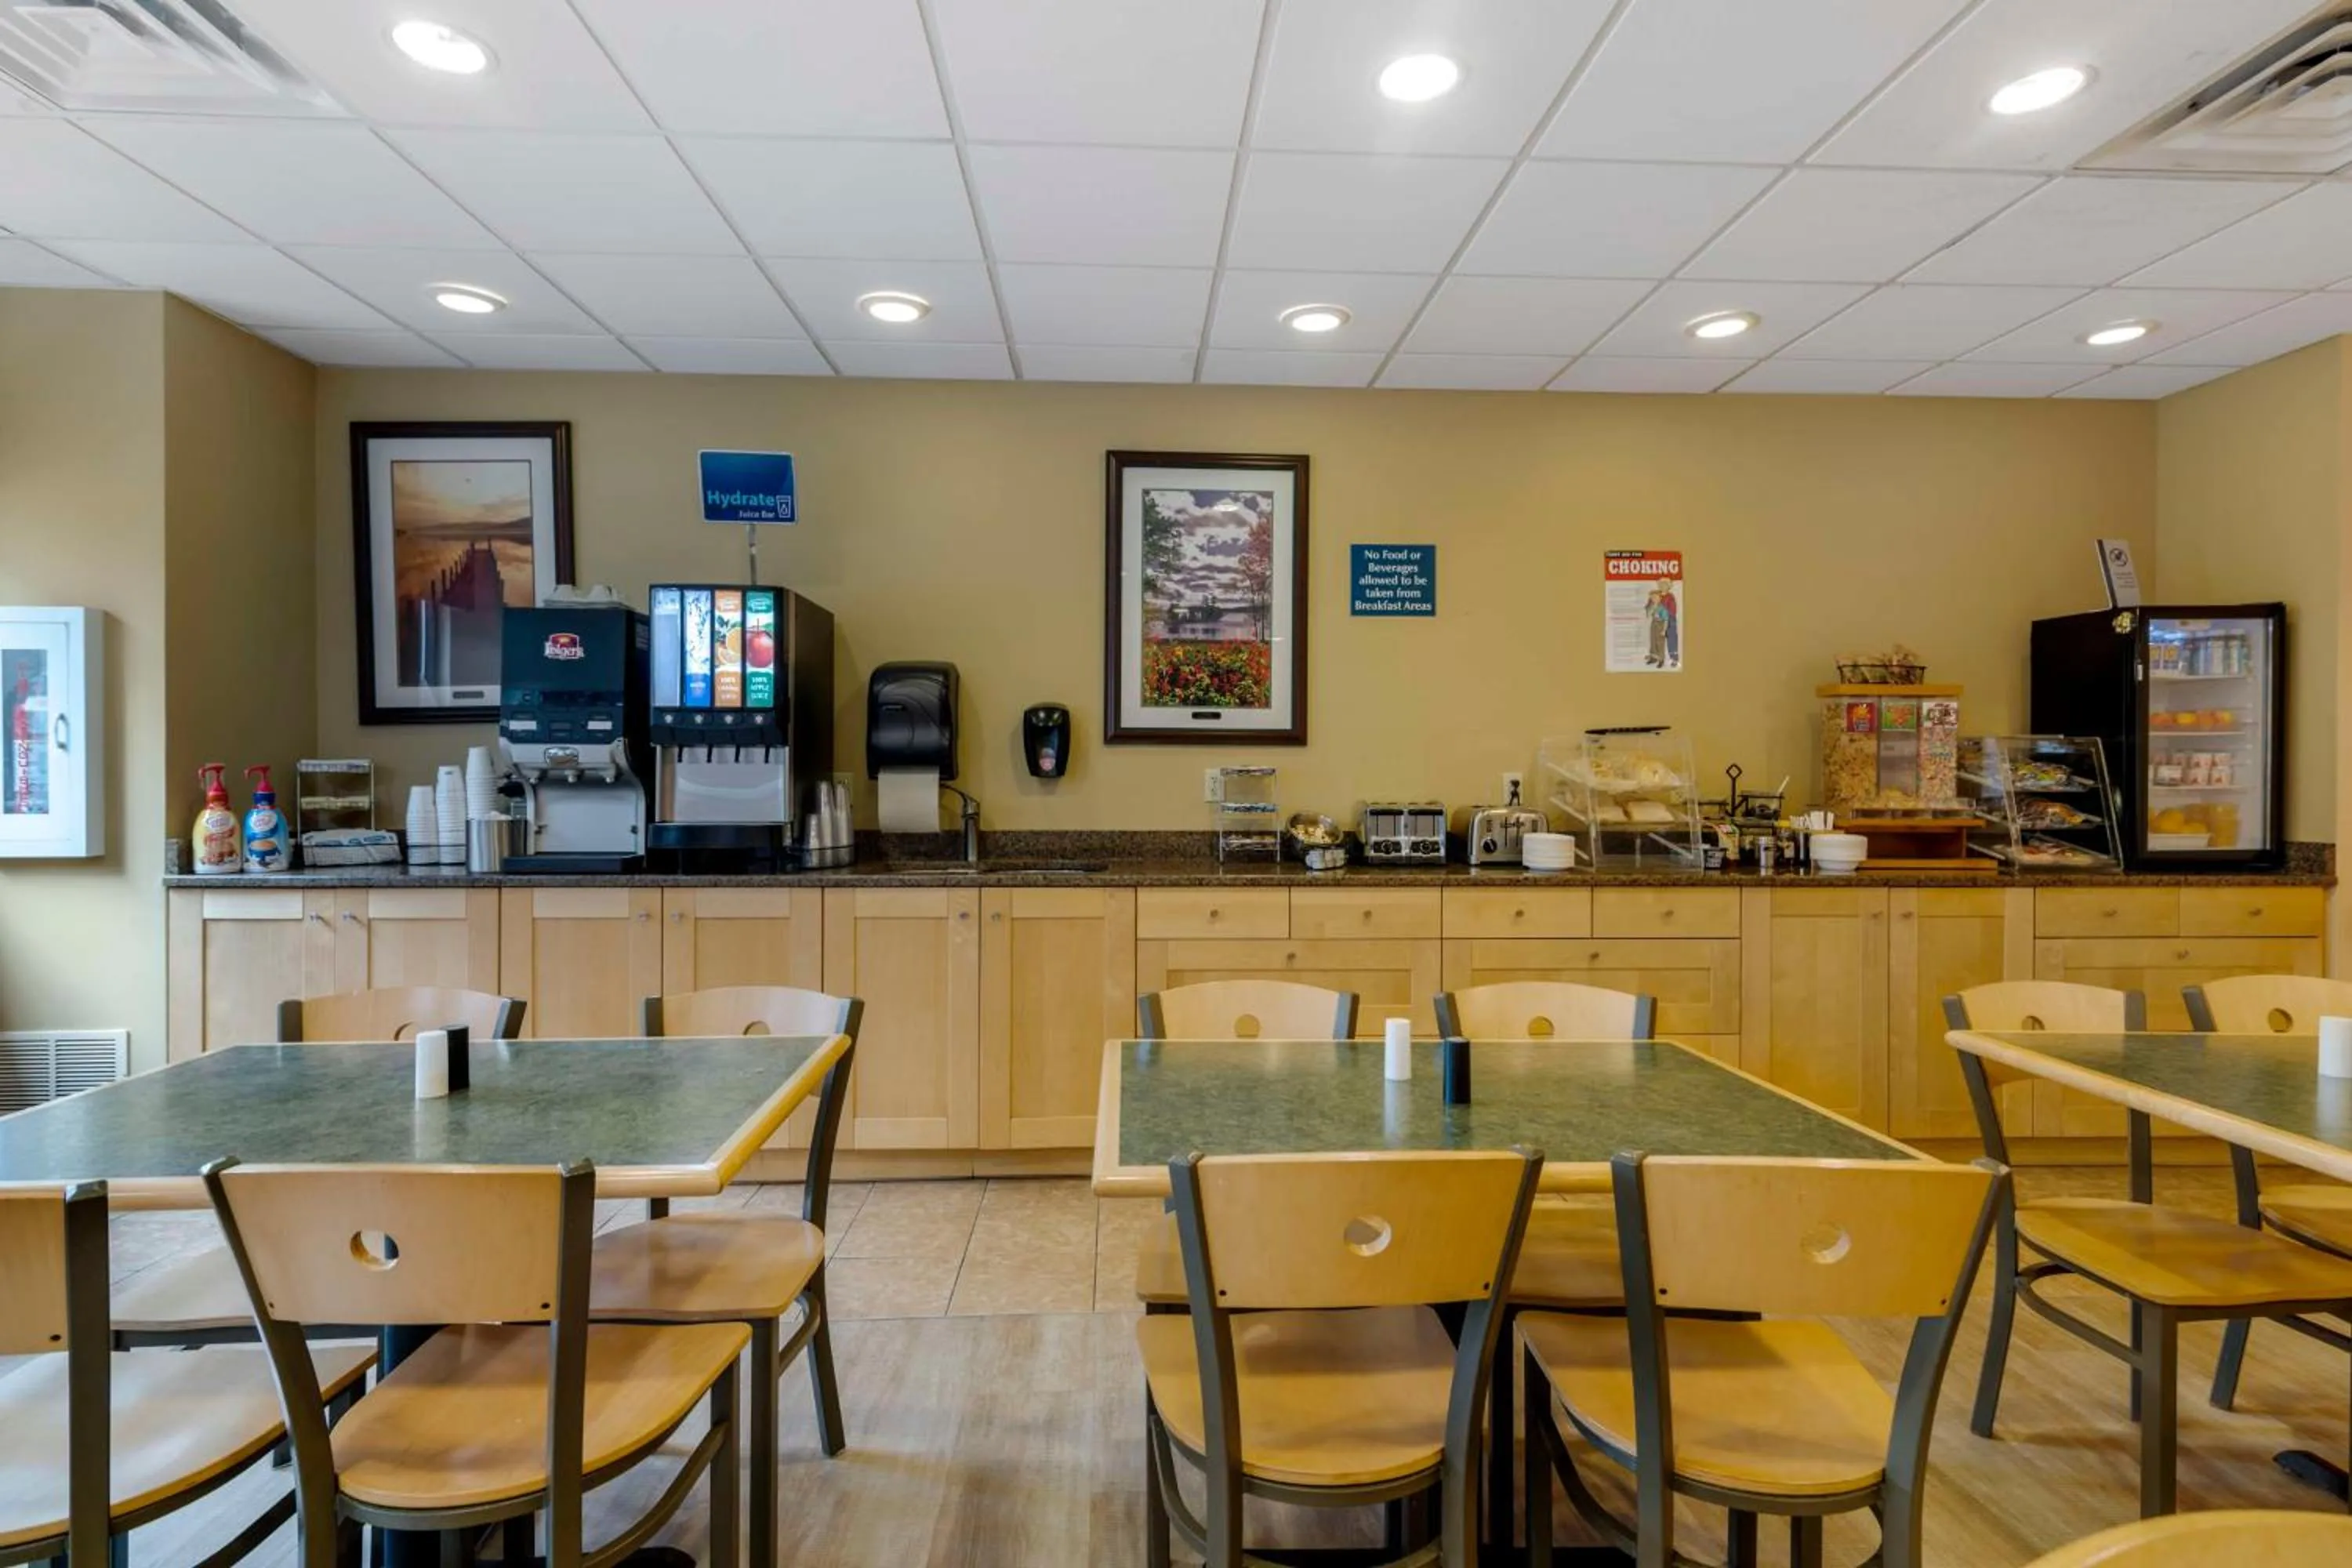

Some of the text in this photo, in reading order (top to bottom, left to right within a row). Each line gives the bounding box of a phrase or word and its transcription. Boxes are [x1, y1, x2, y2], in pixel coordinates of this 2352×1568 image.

[707, 490, 775, 508] Hydrate
[739, 510, 760, 518] Juice
[1364, 550, 1380, 560] No
[1382, 550, 1407, 560] Food
[1368, 563, 1419, 575] Beverages
[1609, 559, 1679, 575] CHOKING
[1358, 575, 1428, 586] allowed to be
[1366, 587, 1421, 598] taken from
[1355, 600, 1432, 611] Breakfast Areas
